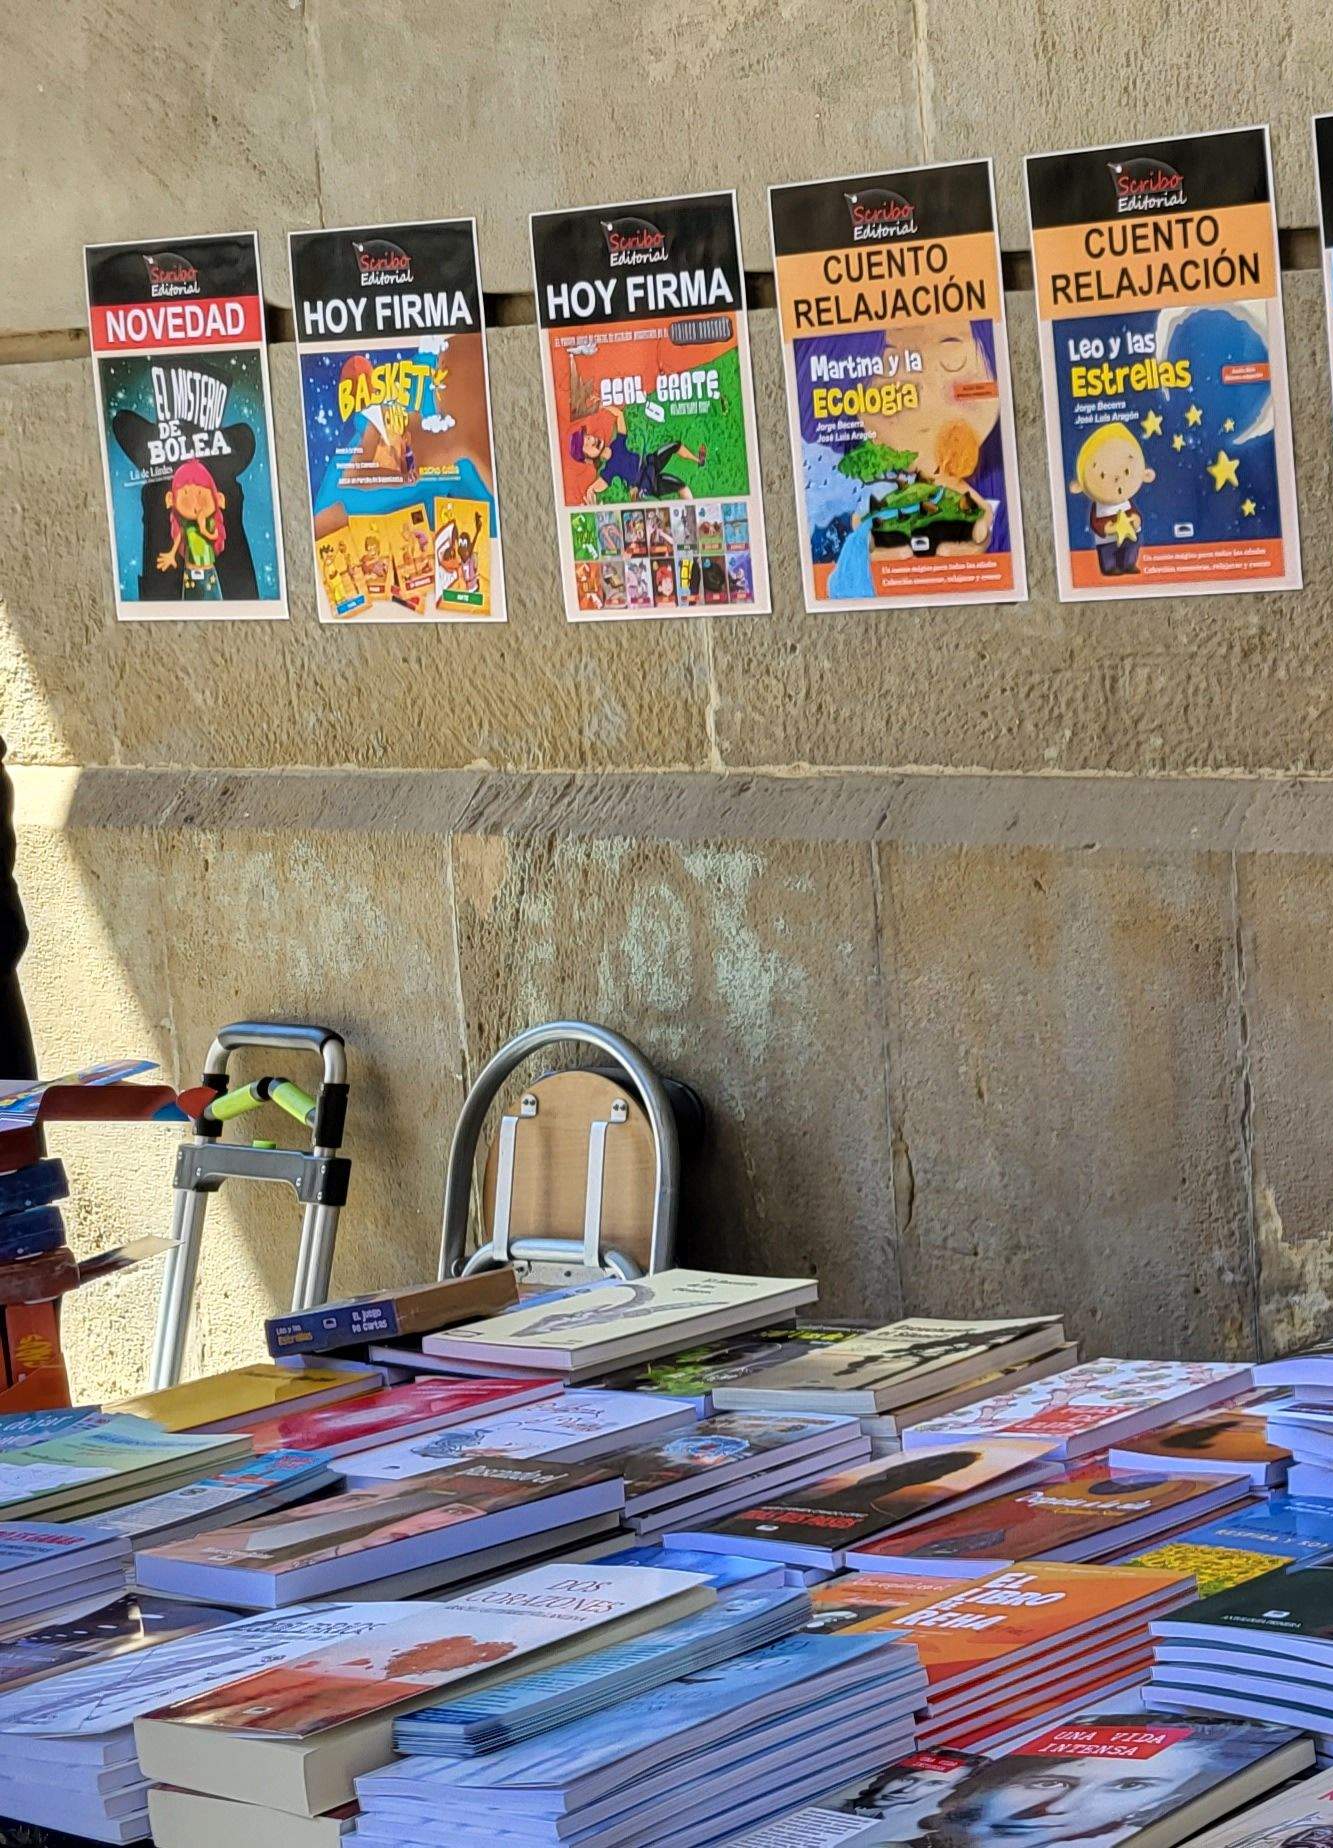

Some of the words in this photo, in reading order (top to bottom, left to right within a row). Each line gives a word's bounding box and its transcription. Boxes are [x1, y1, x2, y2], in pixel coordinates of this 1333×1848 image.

[1116, 172, 1183, 197] Scribo
[1117, 192, 1187, 213] Editorial
[852, 203, 915, 225] Scribo
[854, 221, 918, 241] Editorial
[1084, 214, 1220, 260] CUENTO
[609, 232, 665, 252] Scribo
[360, 251, 411, 272] Scribo
[610, 249, 668, 267] Editorial
[823, 242, 949, 286] CUENTO
[361, 269, 413, 286] Editorial
[1051, 248, 1260, 304] RELAJACIÓN
[151, 282, 200, 297] Editorial
[546, 278, 617, 320] HOY
[626, 268, 734, 313] FIRMA
[794, 275, 987, 329] RELAJACIÓN
[105, 302, 245, 342] NOVEDAD
[303, 298, 367, 335] HOY
[375, 291, 473, 331] FIRMA
[1068, 339, 1104, 362] Leo
[1108, 337, 1121, 360] y
[1127, 331, 1156, 355] las
[810, 355, 884, 382] Martina
[888, 354, 899, 377] y
[905, 350, 923, 372] la
[1071, 358, 1193, 397] Estrellas
[152, 366, 169, 422] EL
[173, 367, 229, 430] MISTERIO
[813, 381, 919, 419] Ecología
[1074, 401, 1096, 413] Jorge
[1097, 400, 1126, 411] Becerra
[816, 421, 836, 433] Jorge
[1074, 413, 1094, 425] José
[1095, 413, 1111, 423] Luis
[1111, 411, 1139, 423] Aragón
[159, 420, 182, 440] DE
[817, 432, 834, 442] José
[835, 432, 849, 441] Luis
[851, 430, 877, 441] Aragón
[148, 431, 232, 465] BOLEA
[546, 1579, 612, 1593] DOS
[982, 1572, 1038, 1589] EL
[465, 1591, 625, 1614] CORAZONES
[965, 1588, 1066, 1607] LIBRO
[1053, 1731, 1096, 1742] UNA
[1111, 1732, 1167, 1745] VIDA
[1038, 1743, 1138, 1756] INTENSA
